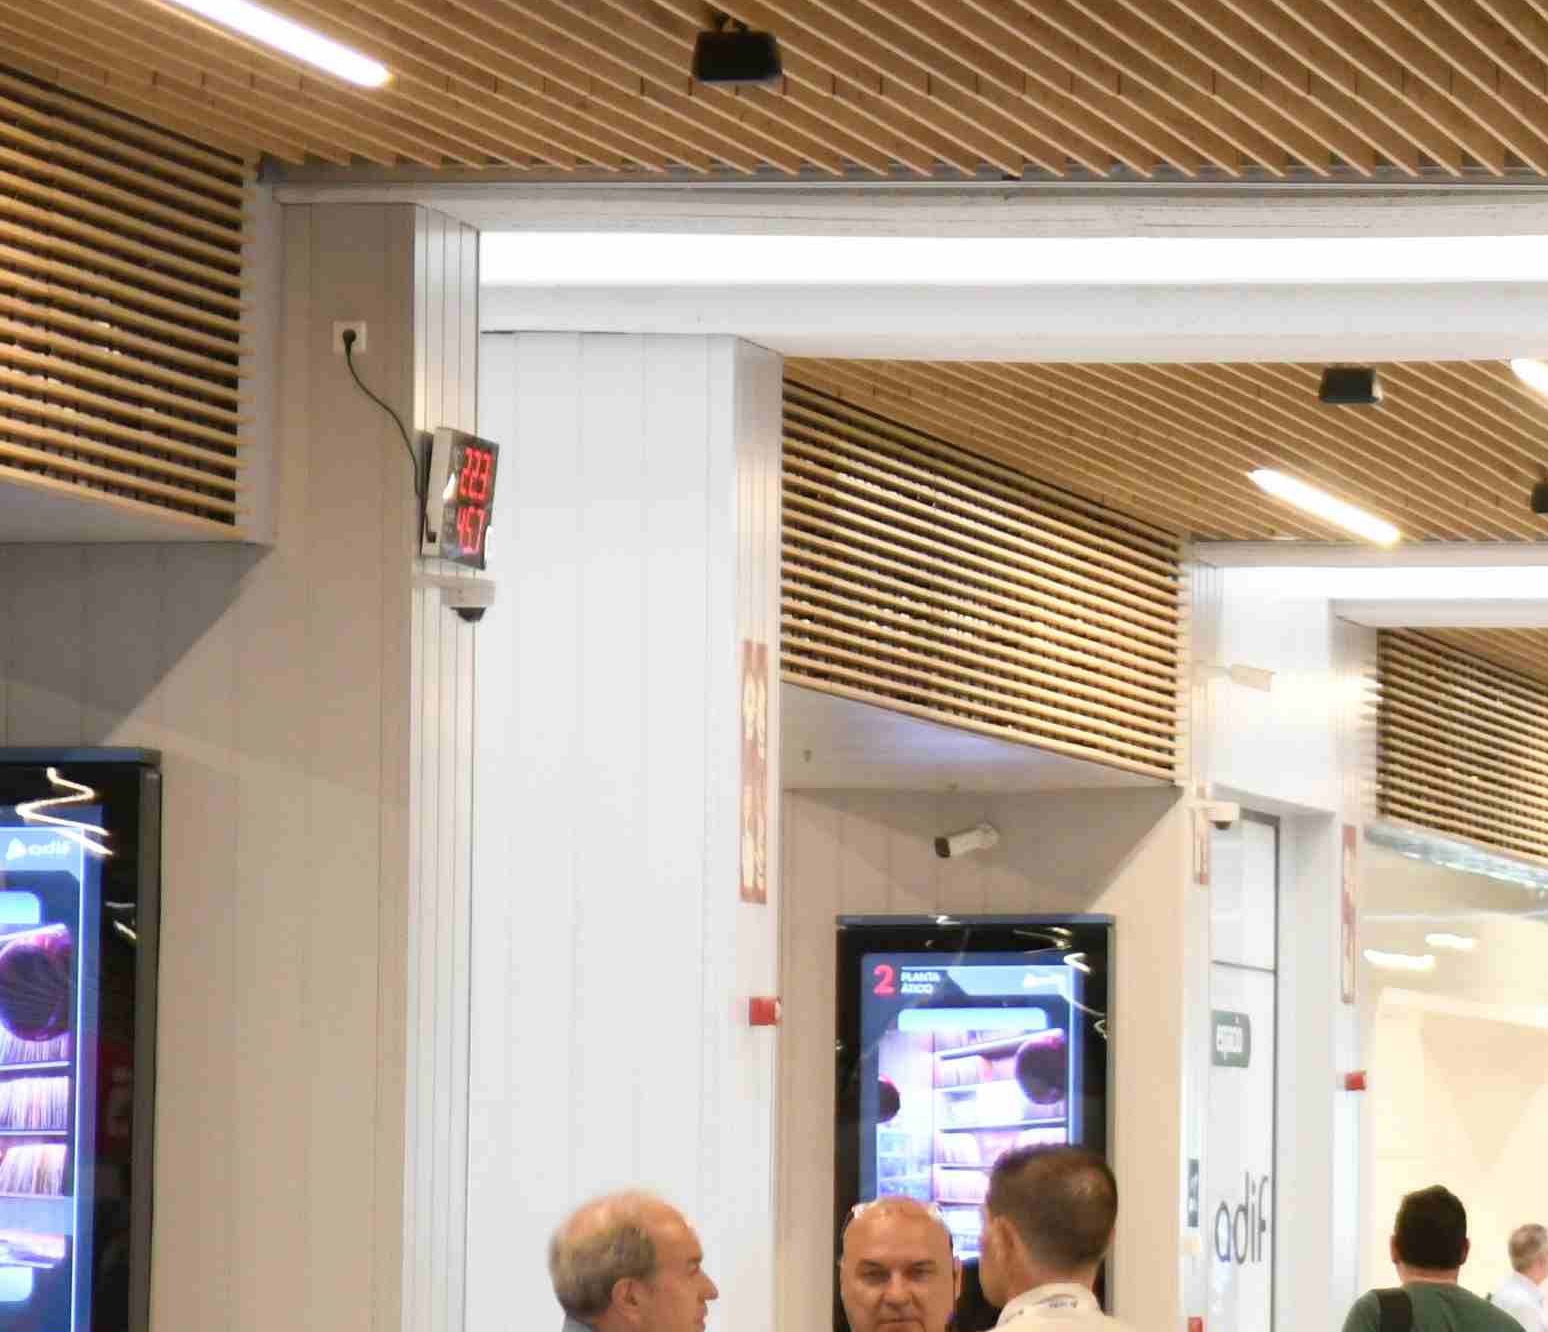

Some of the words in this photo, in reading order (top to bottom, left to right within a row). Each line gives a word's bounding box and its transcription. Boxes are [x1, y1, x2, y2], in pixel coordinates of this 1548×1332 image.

[873, 965, 896, 996] 2
[901, 971, 941, 982] PLANTA
[1215, 1171, 1268, 1264] adif
